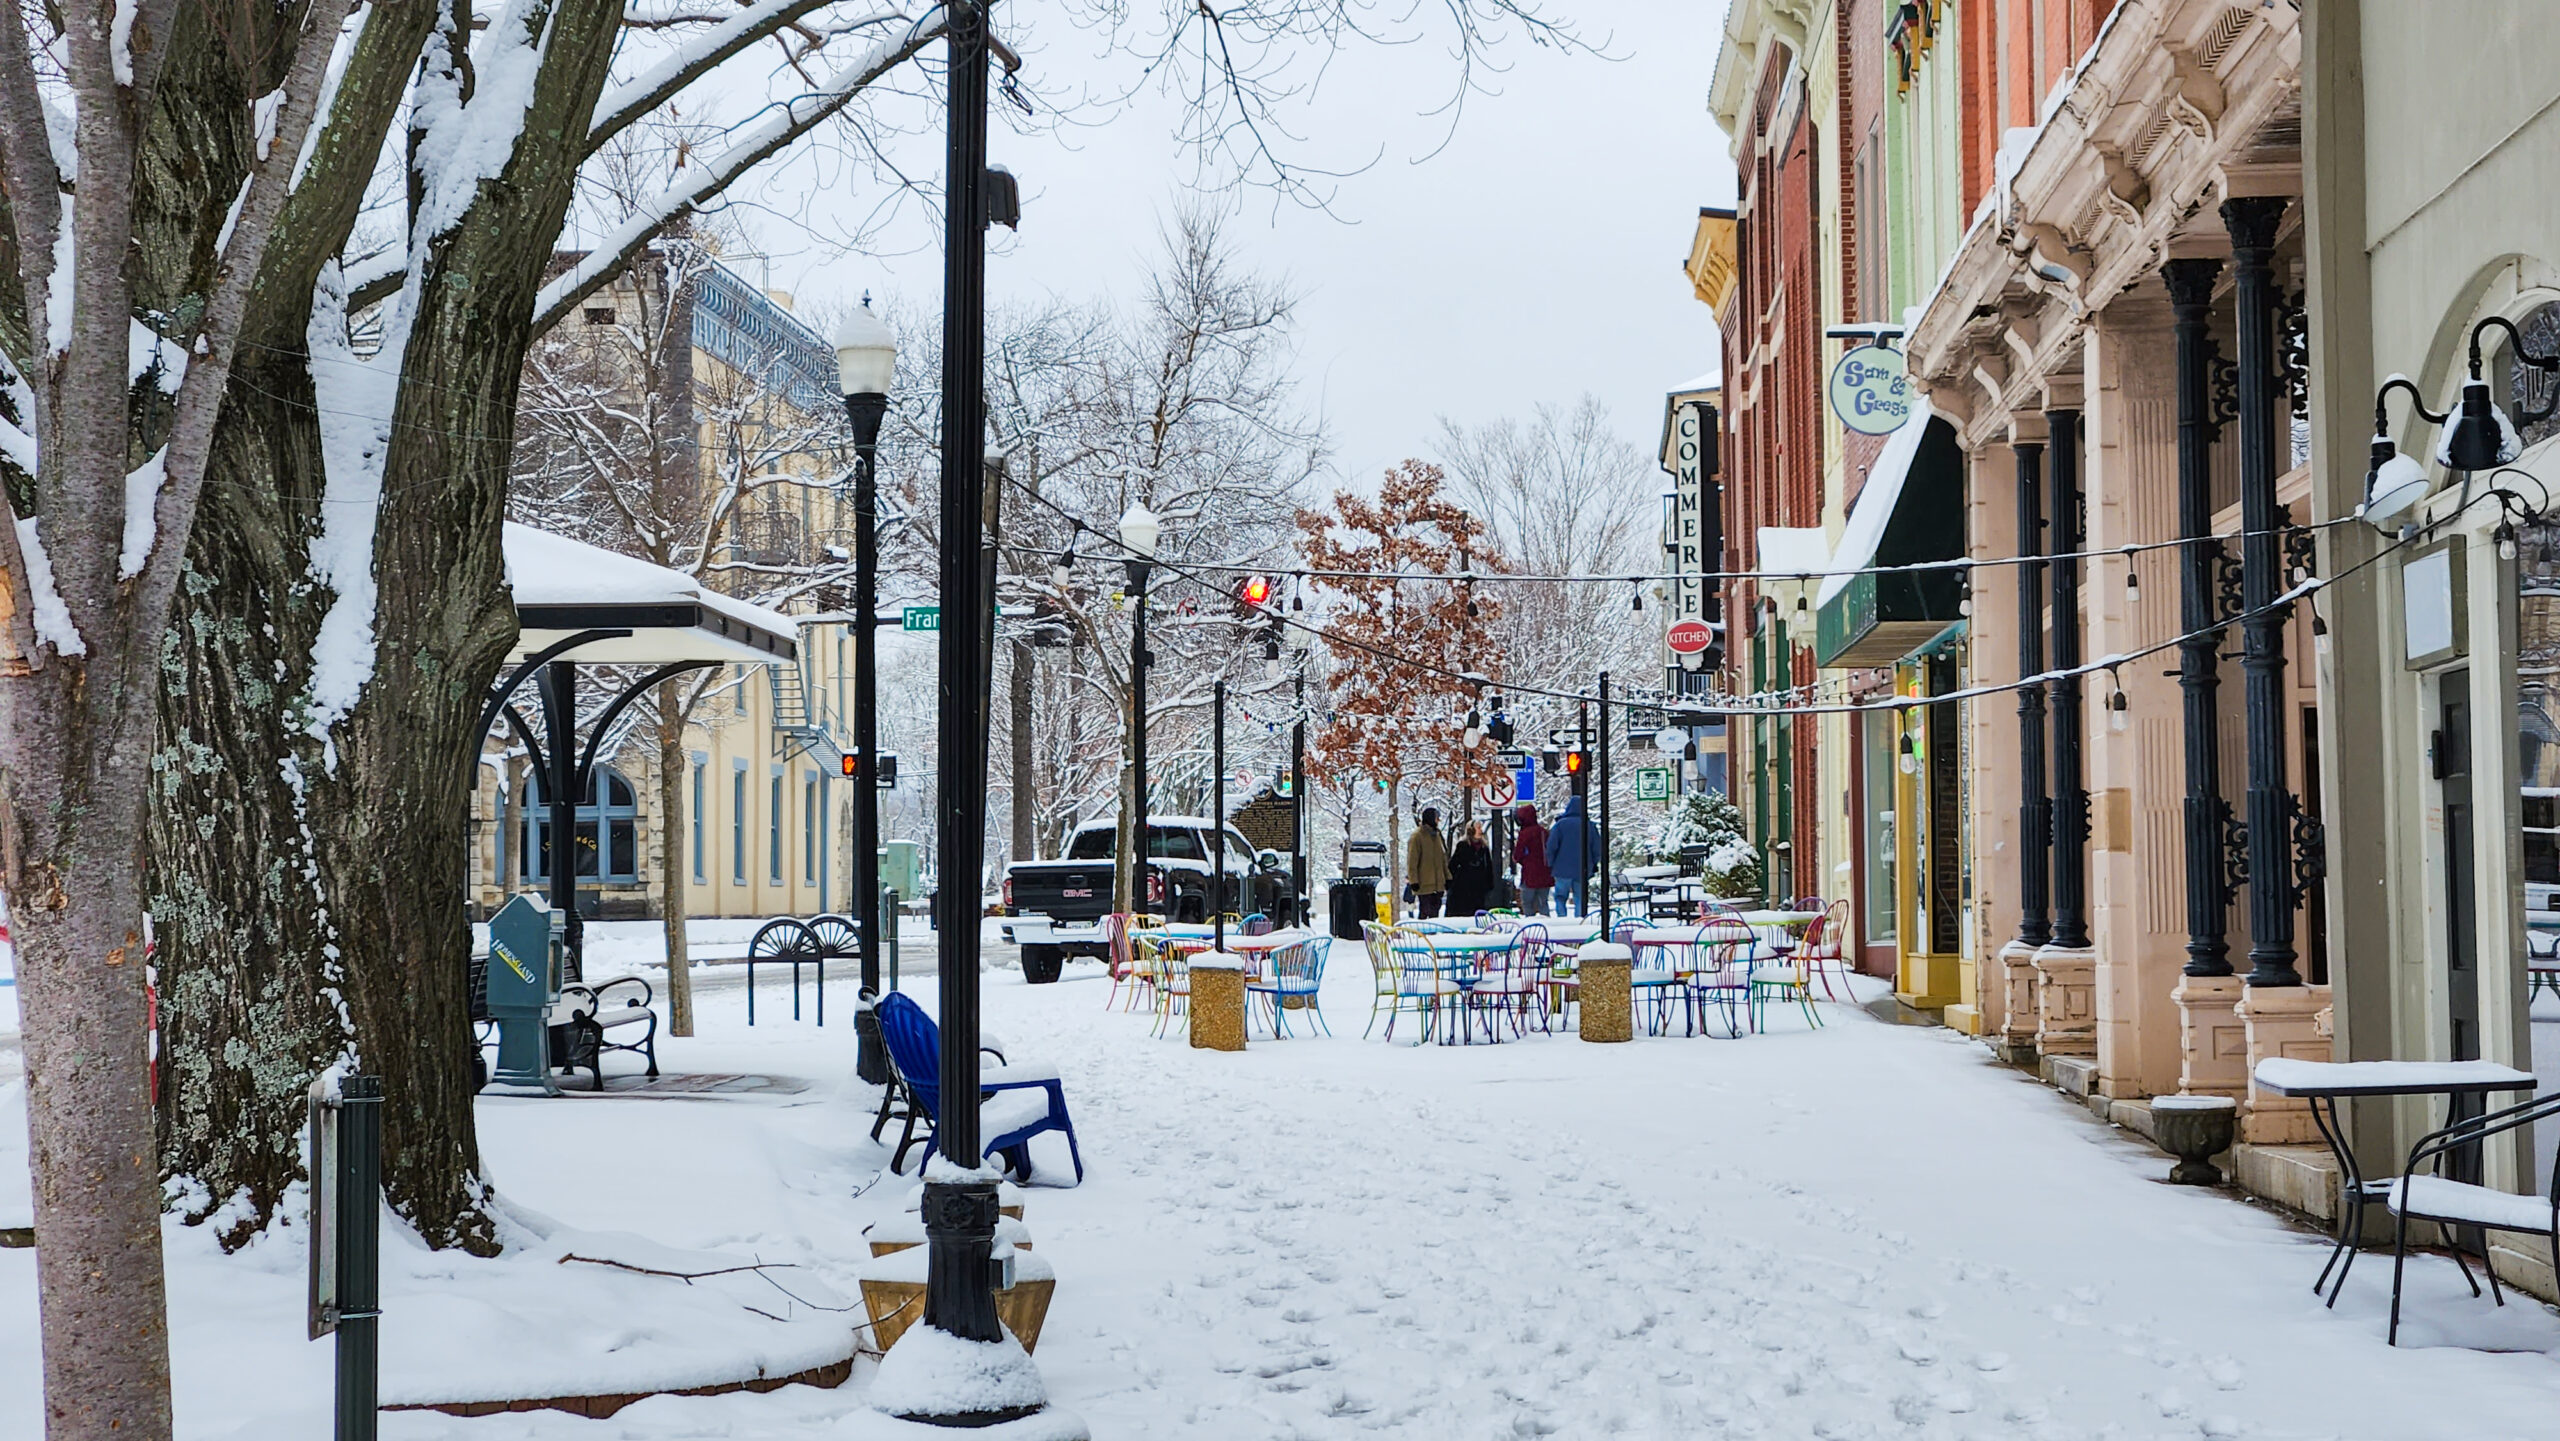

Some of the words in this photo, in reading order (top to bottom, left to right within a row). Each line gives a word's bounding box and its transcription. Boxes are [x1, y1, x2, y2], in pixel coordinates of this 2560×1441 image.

[1843, 361, 1889, 387] Sam
[1889, 375, 1906, 396] &
[1854, 388, 1908, 416] Greg's
[1679, 417, 1700, 614] COMMERCE
[1668, 631, 1709, 645] KITCHEN
[1503, 755, 1520, 763] WAY
[1063, 889, 1092, 898] GMC
